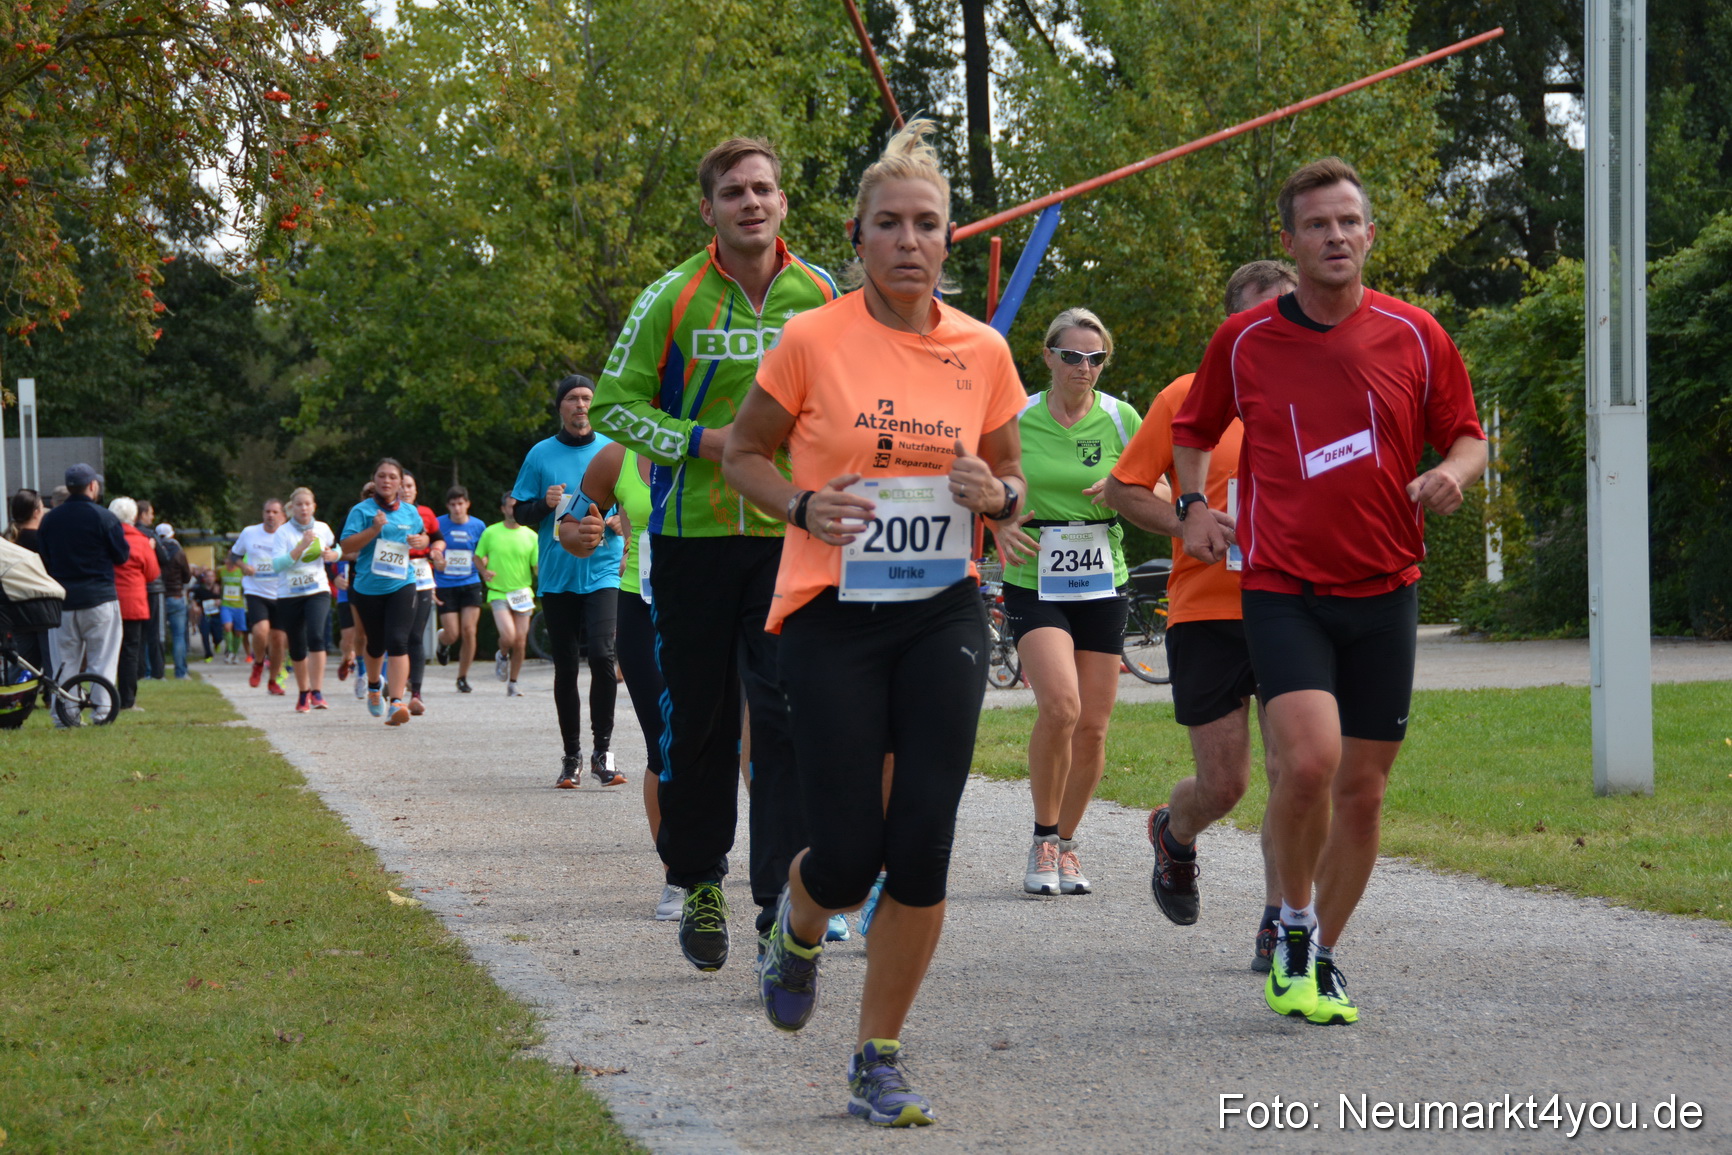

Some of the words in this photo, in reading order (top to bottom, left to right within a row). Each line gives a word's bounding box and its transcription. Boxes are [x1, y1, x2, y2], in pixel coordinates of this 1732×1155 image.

[956, 379, 972, 390] Uli
[854, 412, 961, 438] Atzenhofer
[1324, 443, 1353, 463] DEHN
[894, 457, 943, 470] Reparatur
[892, 488, 935, 499] BOCK
[863, 515, 951, 553] 2007
[380, 550, 404, 565] 2378
[1051, 547, 1104, 572] 2344
[888, 566, 925, 579] Ulrike
[1068, 579, 1090, 588] Heike
